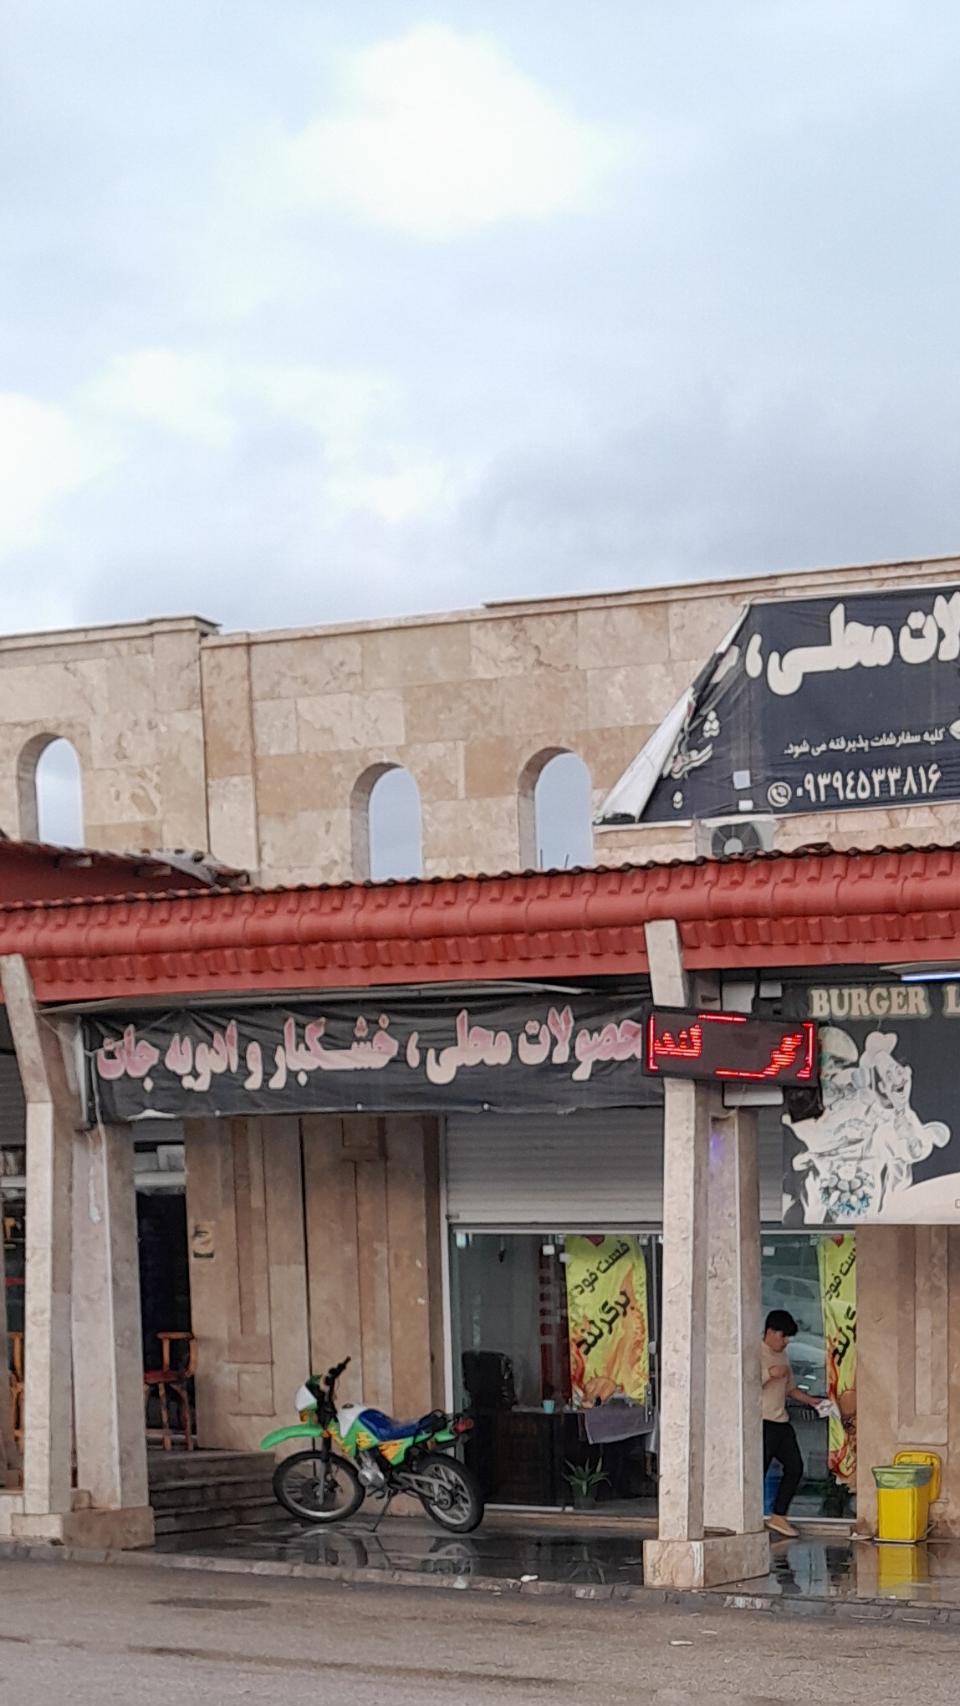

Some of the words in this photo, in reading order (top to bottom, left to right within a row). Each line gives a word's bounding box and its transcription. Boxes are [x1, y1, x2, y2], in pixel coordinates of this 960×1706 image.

[810, 743, 828, 756] می
[828, 734, 869, 753] پذیرفته
[870, 731, 921, 748] سفارشات
[922, 727, 946, 745] کلیه
[810, 985, 929, 1018] BURGER
[97, 1023, 160, 1093] جات
[165, 1018, 238, 1092] ادویه
[268, 1013, 399, 1090] خشکبار
[517, 1004, 642, 1082] حصولات
[243, 1041, 263, 1091] و
[596, 1240, 631, 1274] فست
